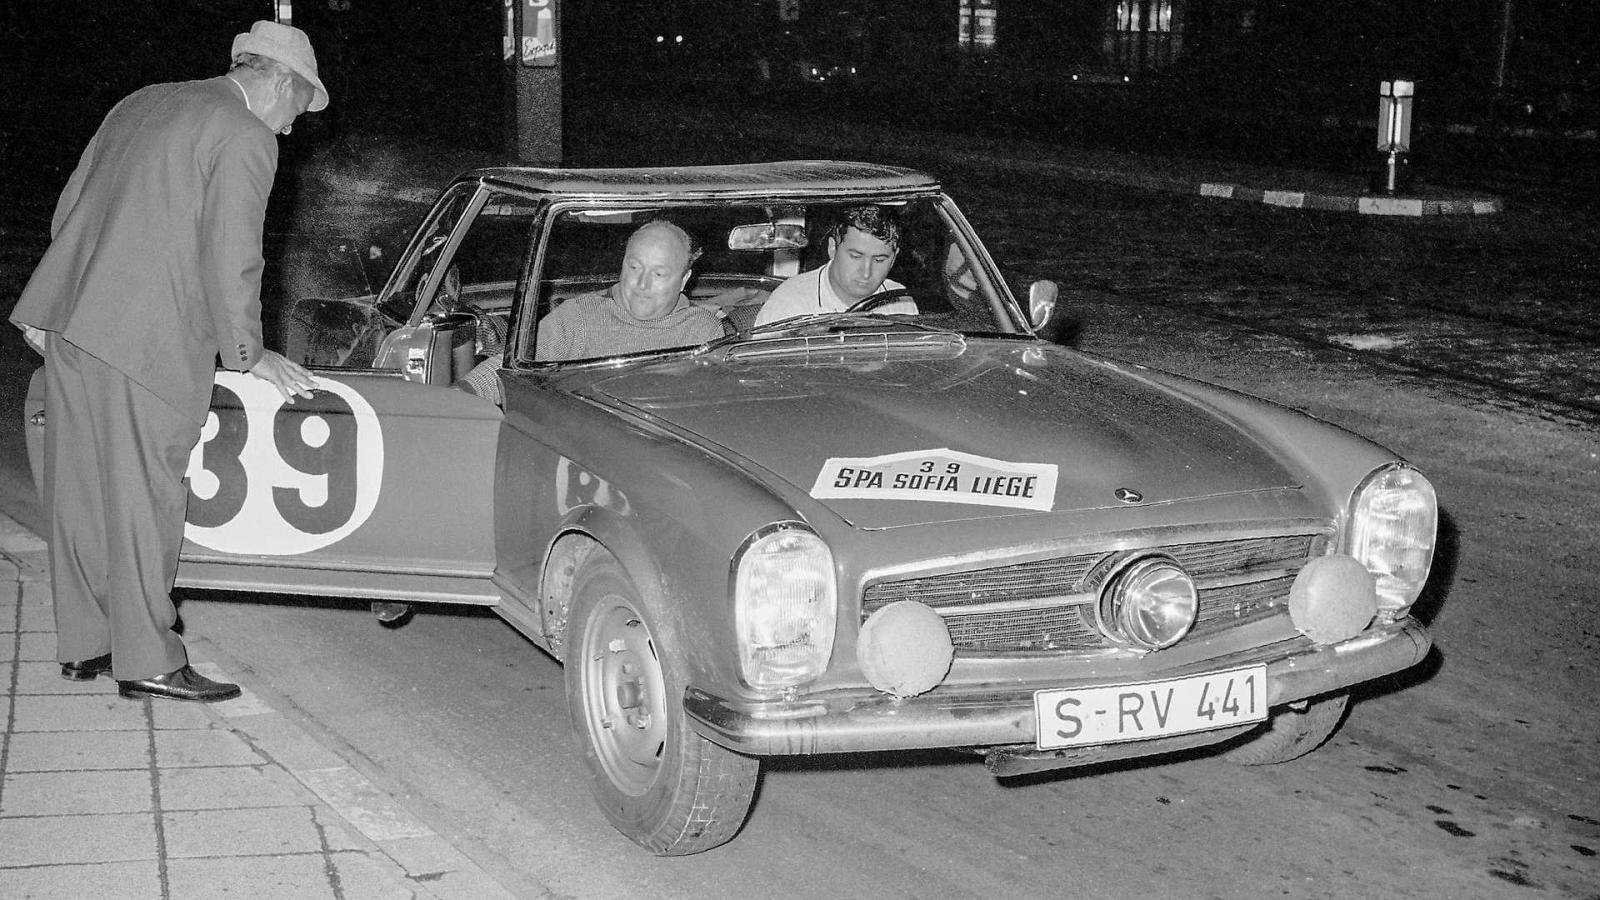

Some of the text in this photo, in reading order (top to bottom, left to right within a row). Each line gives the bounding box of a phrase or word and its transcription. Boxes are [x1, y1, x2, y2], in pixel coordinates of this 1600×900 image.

[182, 384, 358, 535] 39
[834, 467, 1038, 498] SPA SOFIA LIEGE
[1196, 675, 1255, 721] 441
